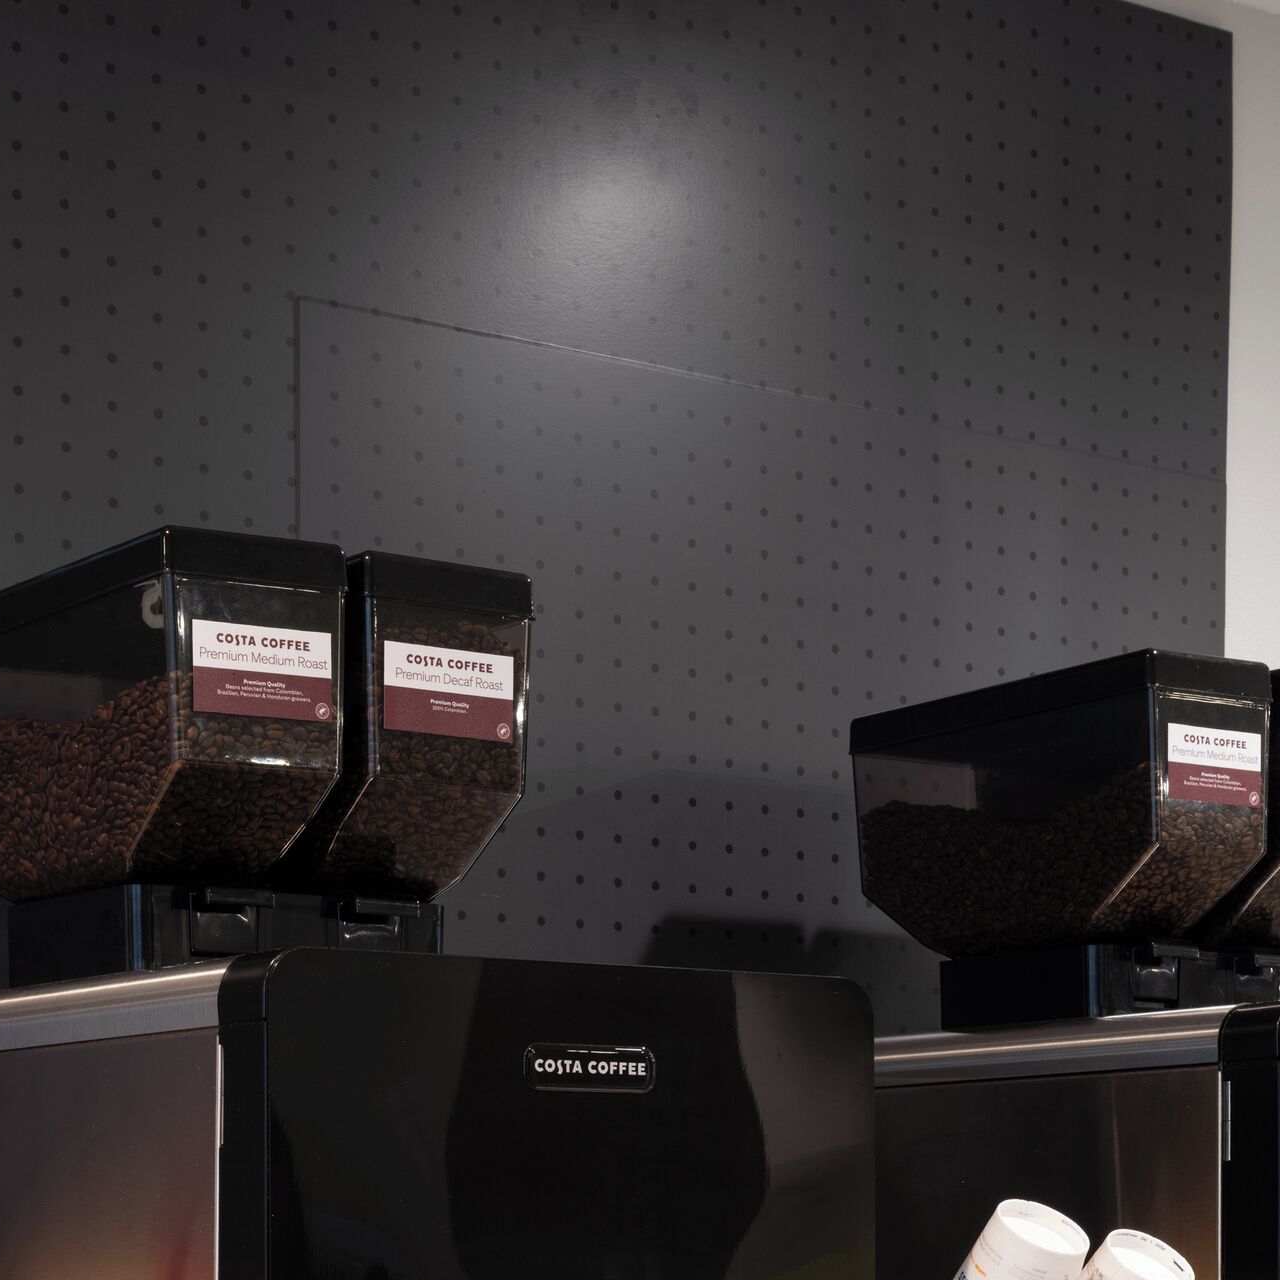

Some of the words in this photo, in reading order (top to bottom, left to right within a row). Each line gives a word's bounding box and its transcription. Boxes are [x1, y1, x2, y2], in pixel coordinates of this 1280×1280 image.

[216, 633, 257, 646] COSTA
[261, 637, 311, 651] COFFEE
[199, 647, 248, 662] Premium
[251, 652, 295, 667] Medium
[297, 657, 328, 670] Roast
[406, 654, 443, 667] COSTA
[447, 659, 493, 673] COFFEE
[395, 667, 440, 683] Premium
[443, 674, 473, 687] Decaf
[475, 678, 503, 691] Roast
[452, 701, 470, 709] Quality
[1184, 734, 1210, 745] COSTA
[1214, 738, 1247, 749] COFFEE
[535, 1058, 582, 1075] COSTA
[587, 1061, 647, 1076] COFFEE
